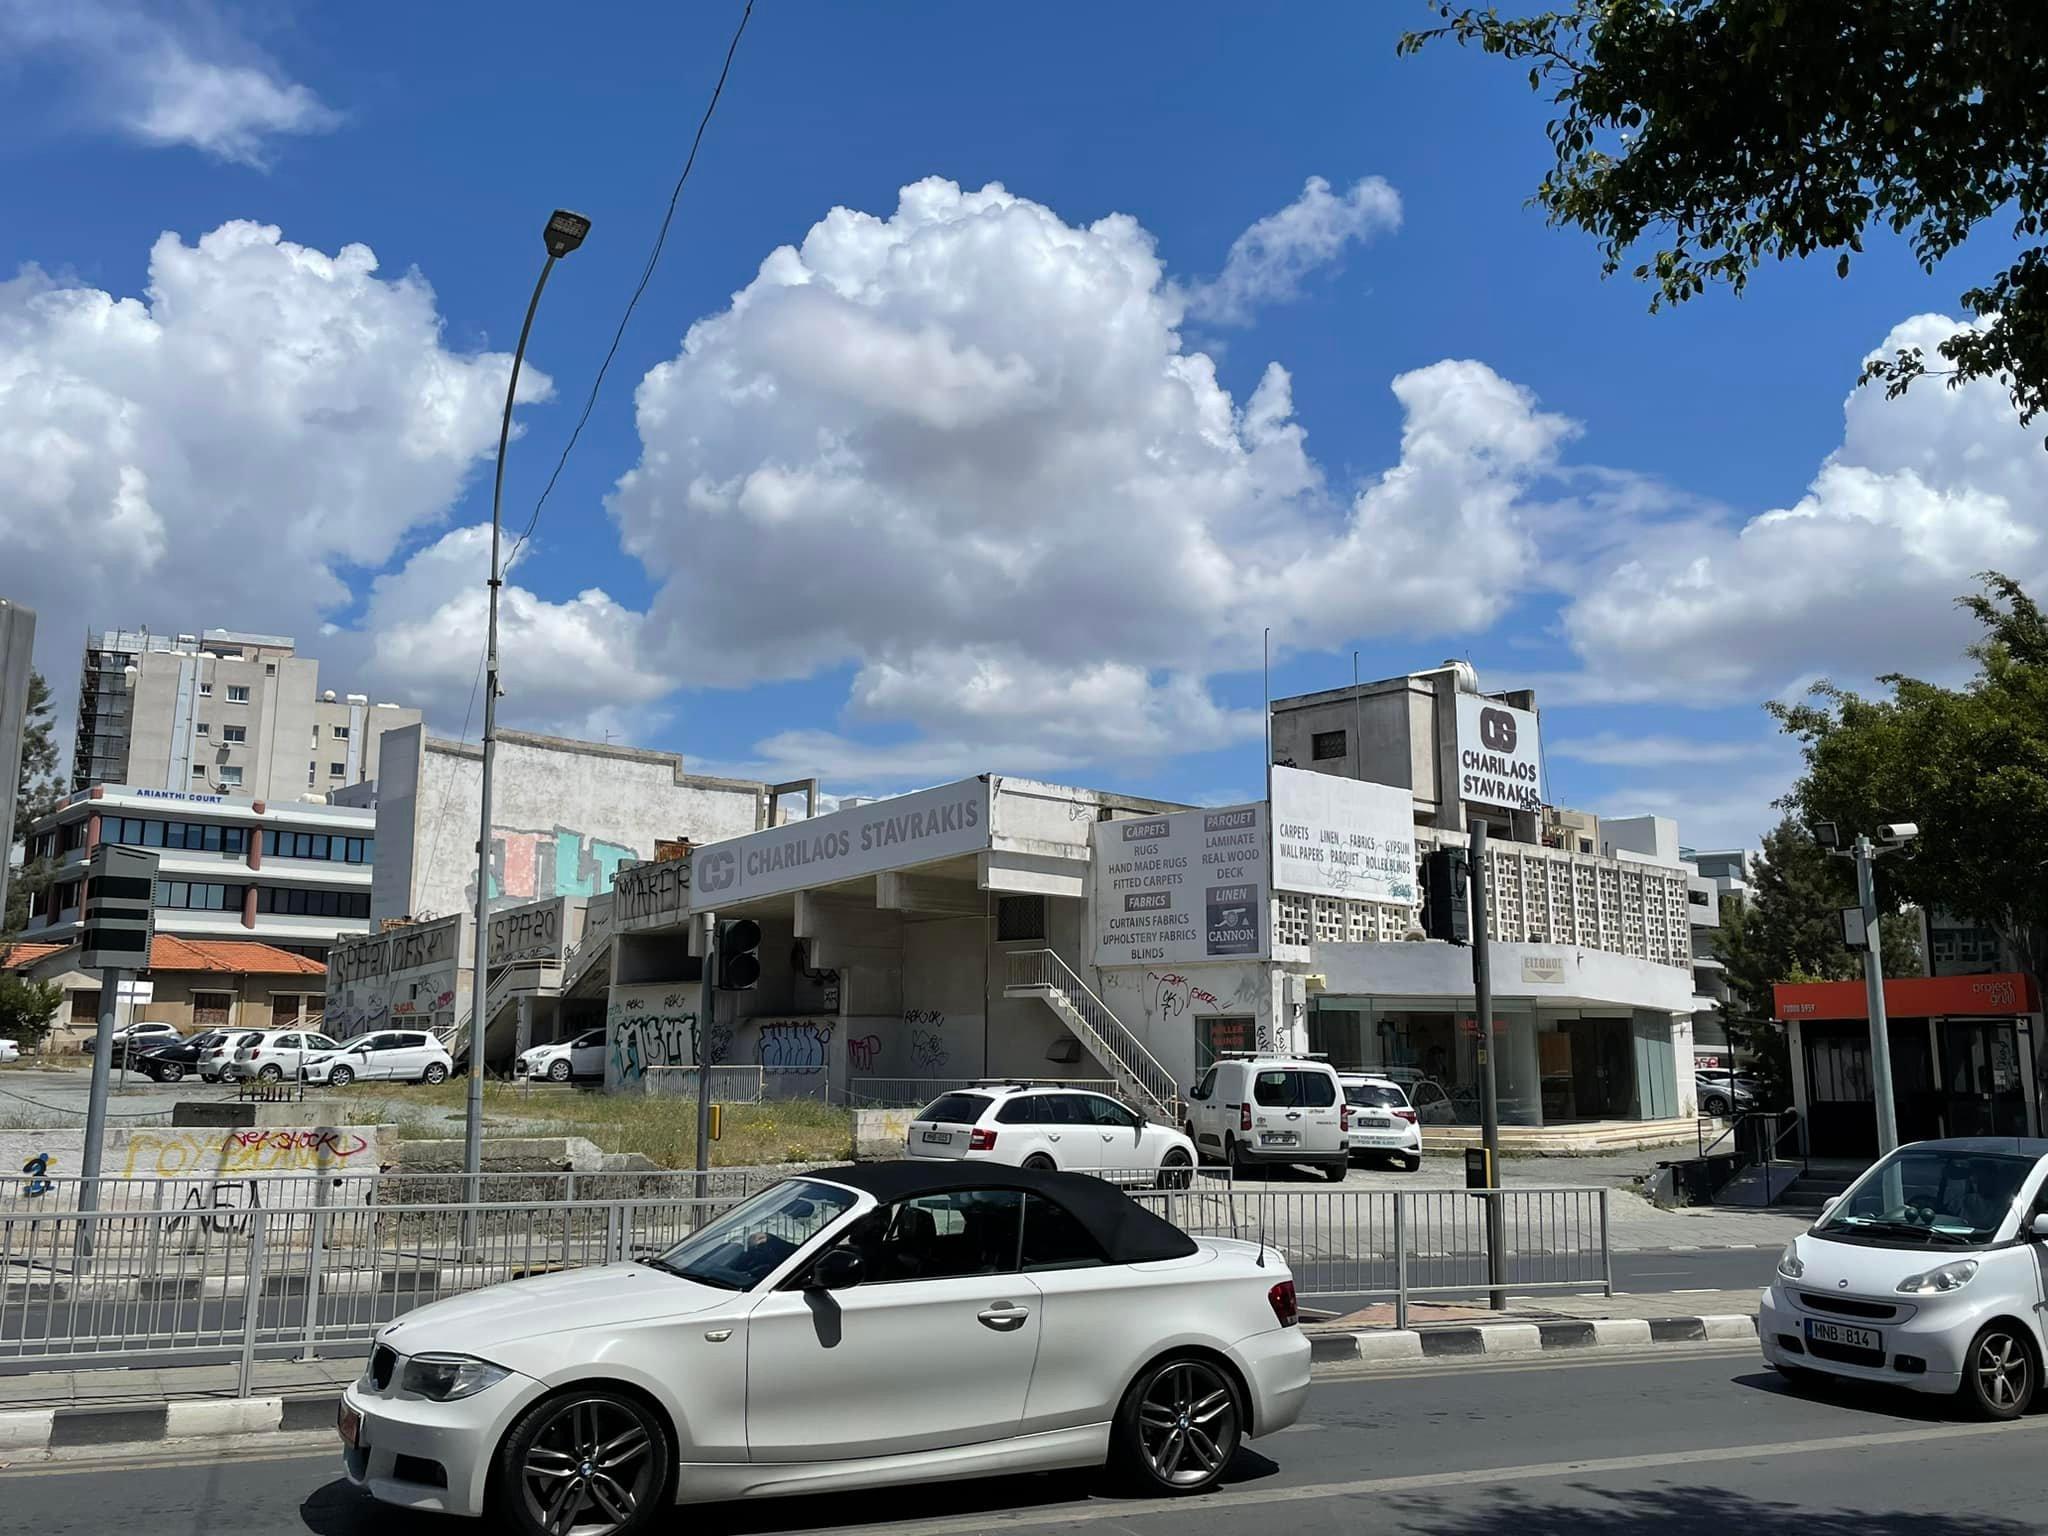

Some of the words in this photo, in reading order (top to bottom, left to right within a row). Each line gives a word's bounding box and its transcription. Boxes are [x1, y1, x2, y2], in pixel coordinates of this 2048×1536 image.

[1462, 750, 1536, 782] CHARILAOS
[136, 789, 185, 800] ARIANTHI
[189, 794, 223, 804] COURT
[1463, 774, 1538, 803] STAVRAKIS
[1207, 812, 1252, 828] PARQUET
[746, 830, 850, 877] CHARILAOS
[860, 800, 978, 851] STAVRAKIS
[1126, 823, 1166, 838] CARPETS
[1206, 833, 1255, 848] LAMINATE
[1280, 823, 1309, 840] CARPETS
[1320, 829, 1339, 845] LINEN
[1350, 834, 1375, 850] FABRICS
[1385, 840, 1410, 855] GYPSUM
[1134, 844, 1159, 856] RUGS
[1202, 851, 1226, 865] REAL
[1227, 849, 1259, 863] WOOD
[1280, 843, 1298, 859] WALL
[1299, 846, 1324, 862] PAPERS
[1331, 849, 1359, 866] PARQUET
[1365, 855, 1388, 871] ROLLER
[1108, 863, 1132, 874] HAND
[1134, 859, 1161, 872] MADE
[1163, 856, 1188, 869] RUGS
[1217, 867, 1244, 879] DECK
[1113, 877, 1141, 890] FITTED
[1143, 873, 1183, 887] CARPETS
[1129, 895, 1166, 908] FABRICS
[1216, 888, 1247, 901] LINEN
[1110, 916, 1150, 929] CURTAINS
[1152, 913, 1189, 927] FABRICS
[1103, 931, 1157, 945] UPHOLSTERY
[1159, 929, 1197, 942] FABRICS
[1208, 929, 1255, 942] CANNON
[1131, 947, 1164, 960] BLINDS
[1814, 1323, 1838, 1340] MNB
[1847, 1329, 1869, 1346] 814
